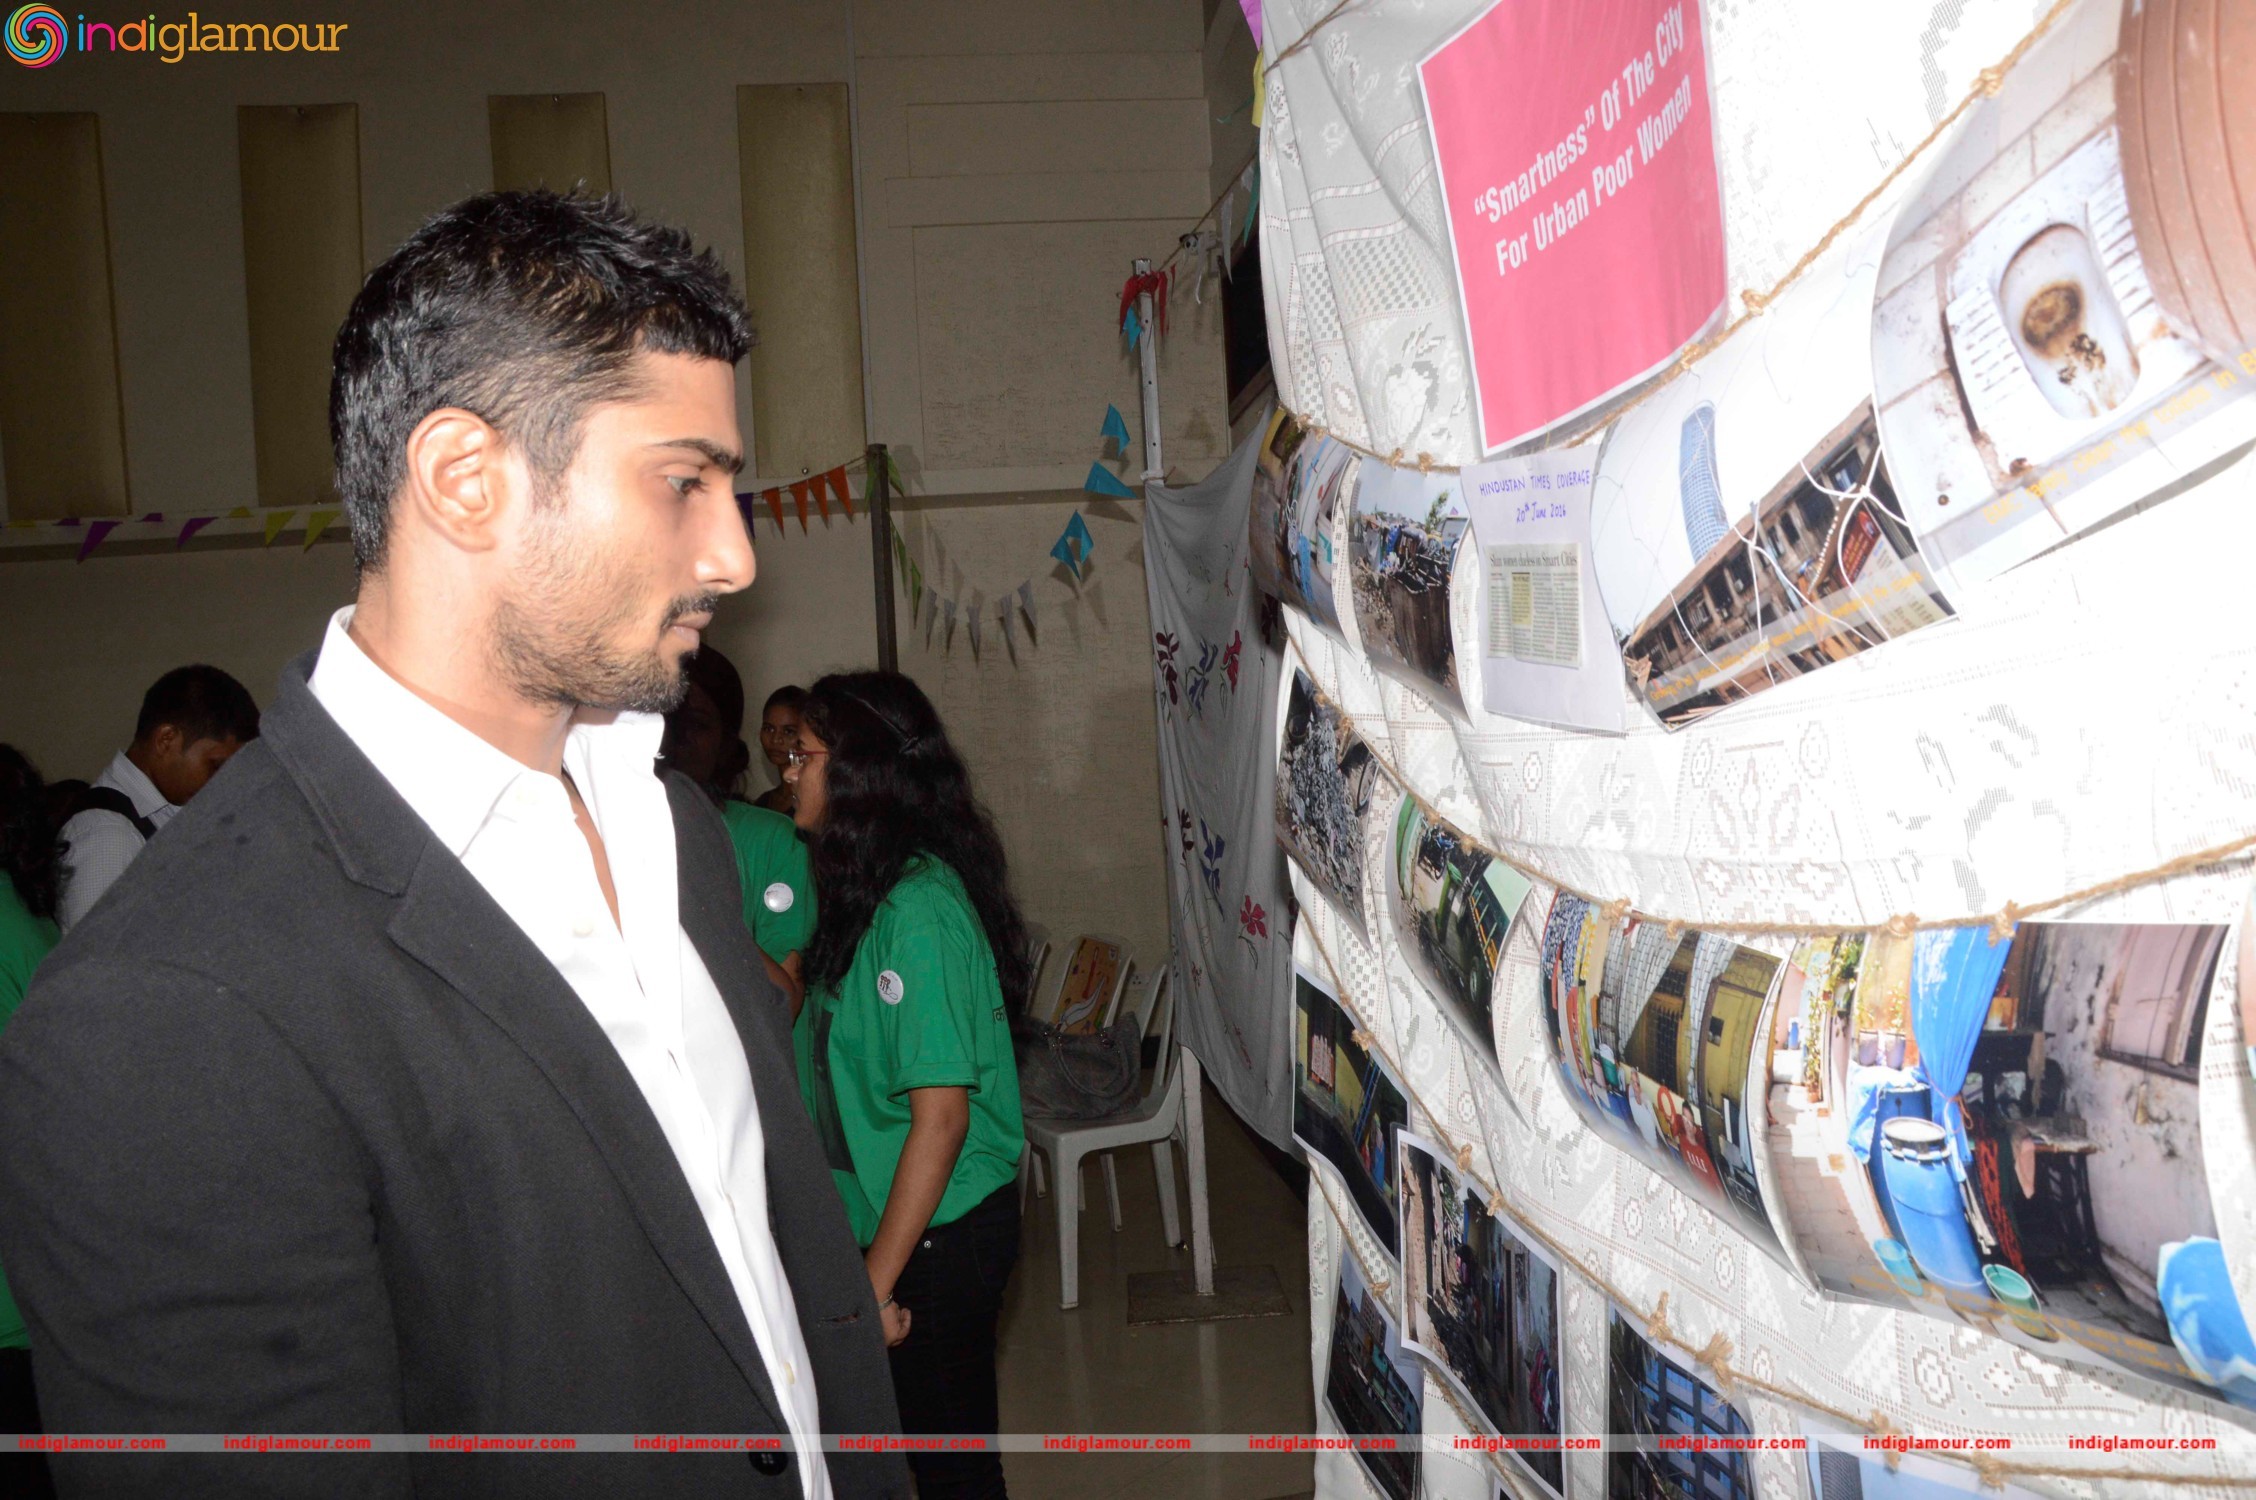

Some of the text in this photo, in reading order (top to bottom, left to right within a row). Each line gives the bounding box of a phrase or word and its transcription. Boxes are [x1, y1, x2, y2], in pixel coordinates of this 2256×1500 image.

[1601, 78, 1622, 132] Of
[1623, 52, 1654, 106] The
[1655, 1, 1684, 69] City
[1496, 74, 1692, 277] For Urban Poor Women
[2119, 420, 2150, 444] the
[2238, 348, 2256, 375] B
[1479, 469, 1590, 496] HINDUSTAN TIMES COVERAGE
[1531, 501, 1547, 522] June
[1550, 503, 1567, 518] 2016
[1542, 552, 1560, 567] Smart
[1686, 1150, 1708, 1173] ELLE
